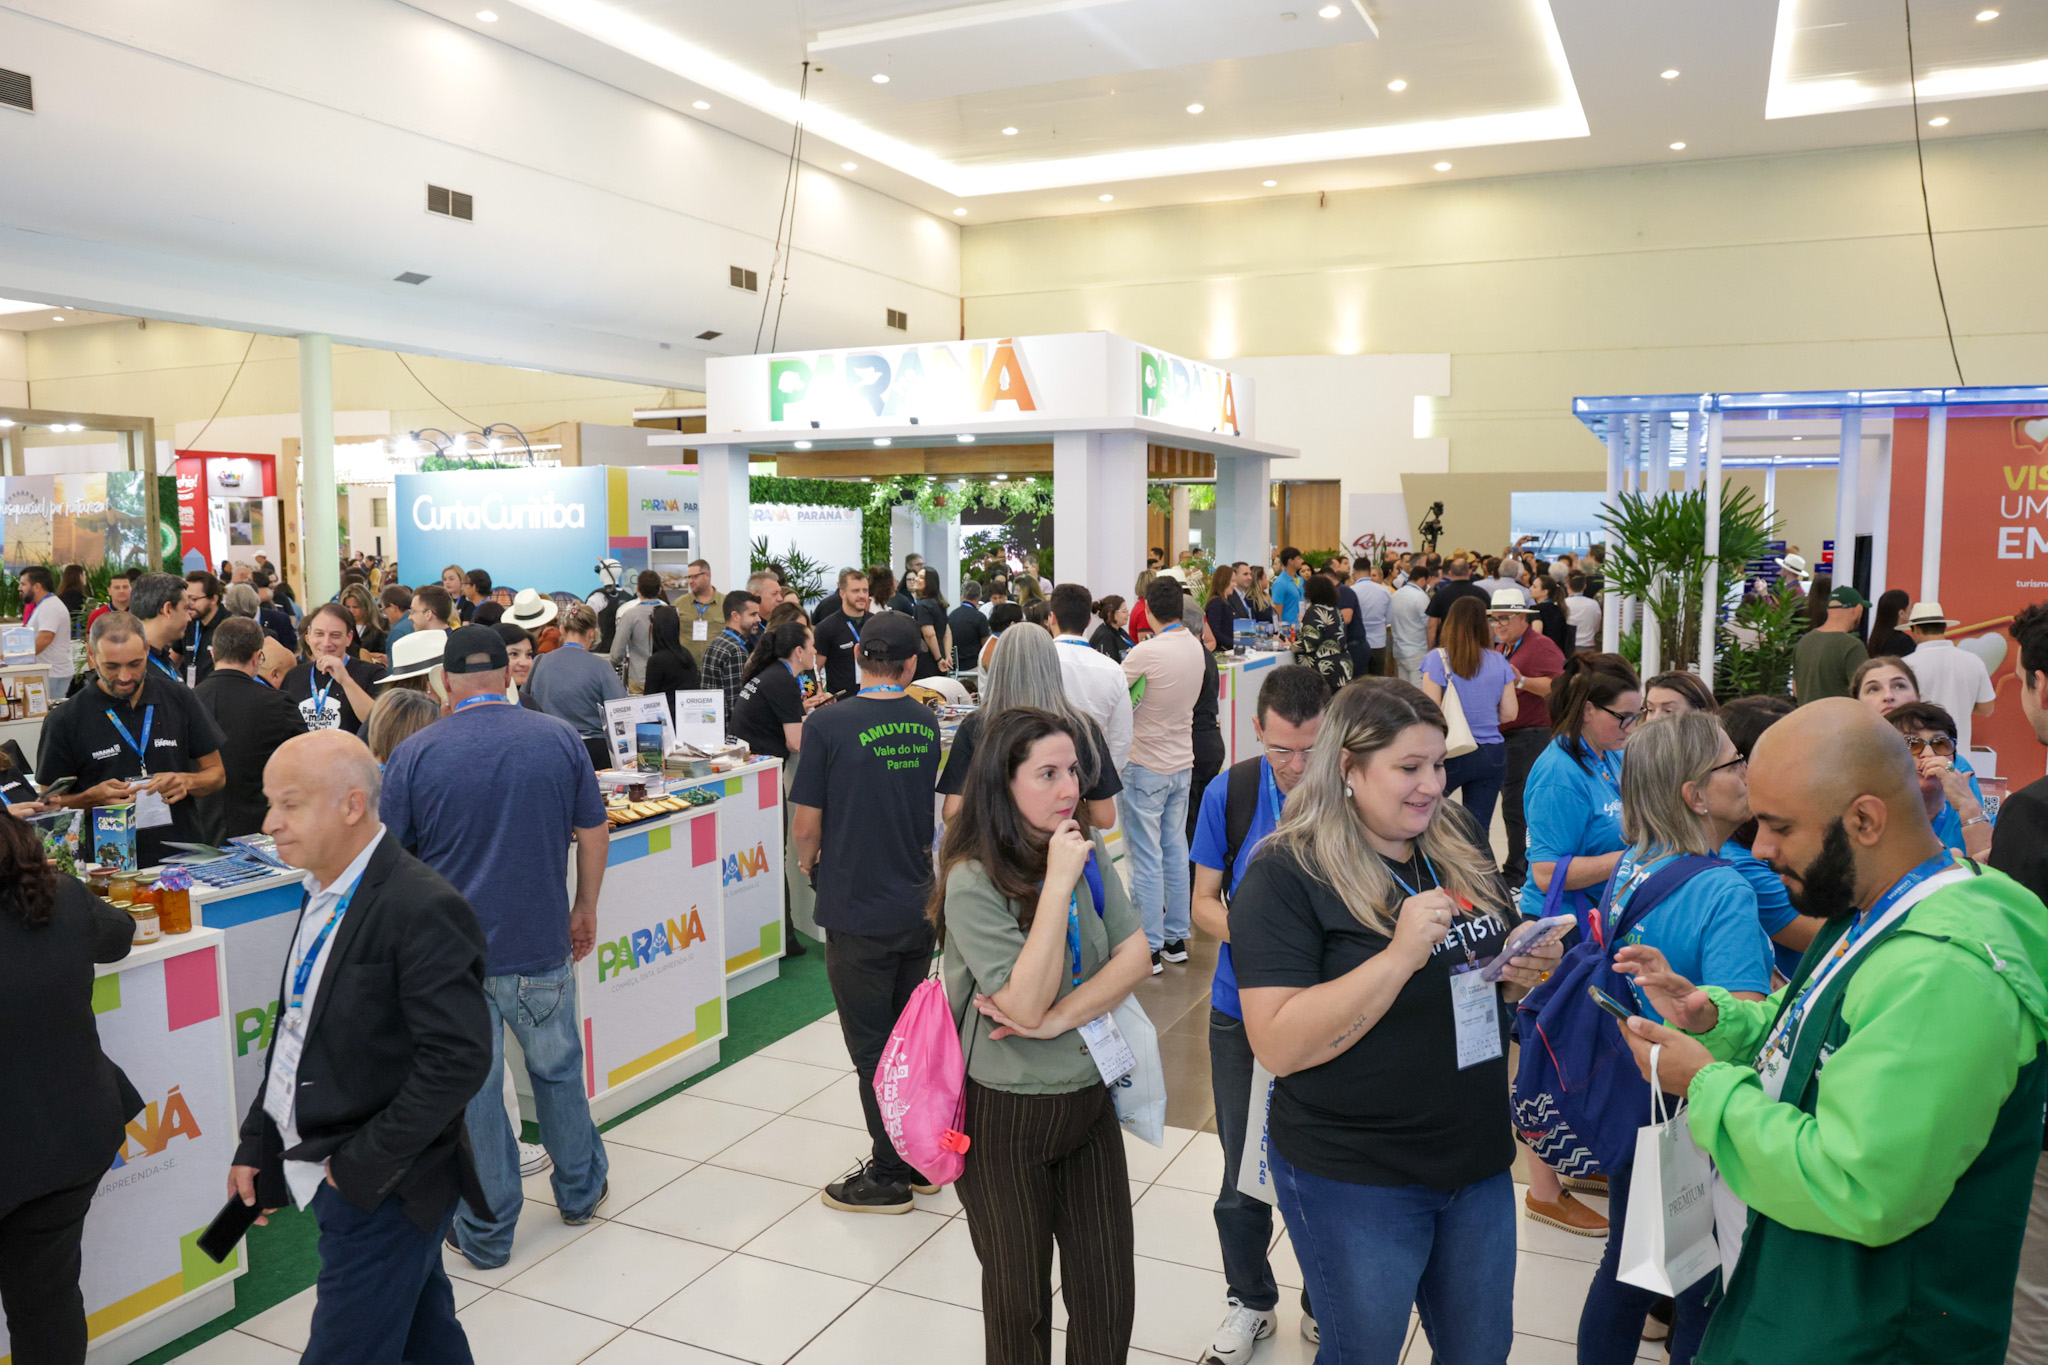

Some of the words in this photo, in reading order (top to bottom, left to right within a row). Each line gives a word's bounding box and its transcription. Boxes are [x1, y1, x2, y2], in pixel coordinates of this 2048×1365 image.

[684, 503, 699, 511] PAR
[858, 722, 936, 747] AMUVITUR
[873, 745, 896, 757] Vale
[897, 744, 911, 754] do
[886, 757, 920, 770] Paraná
[597, 904, 706, 984] PARANÁ
[111, 1084, 203, 1171] NÁ
[1668, 1183, 1706, 1217] PREMIUM
